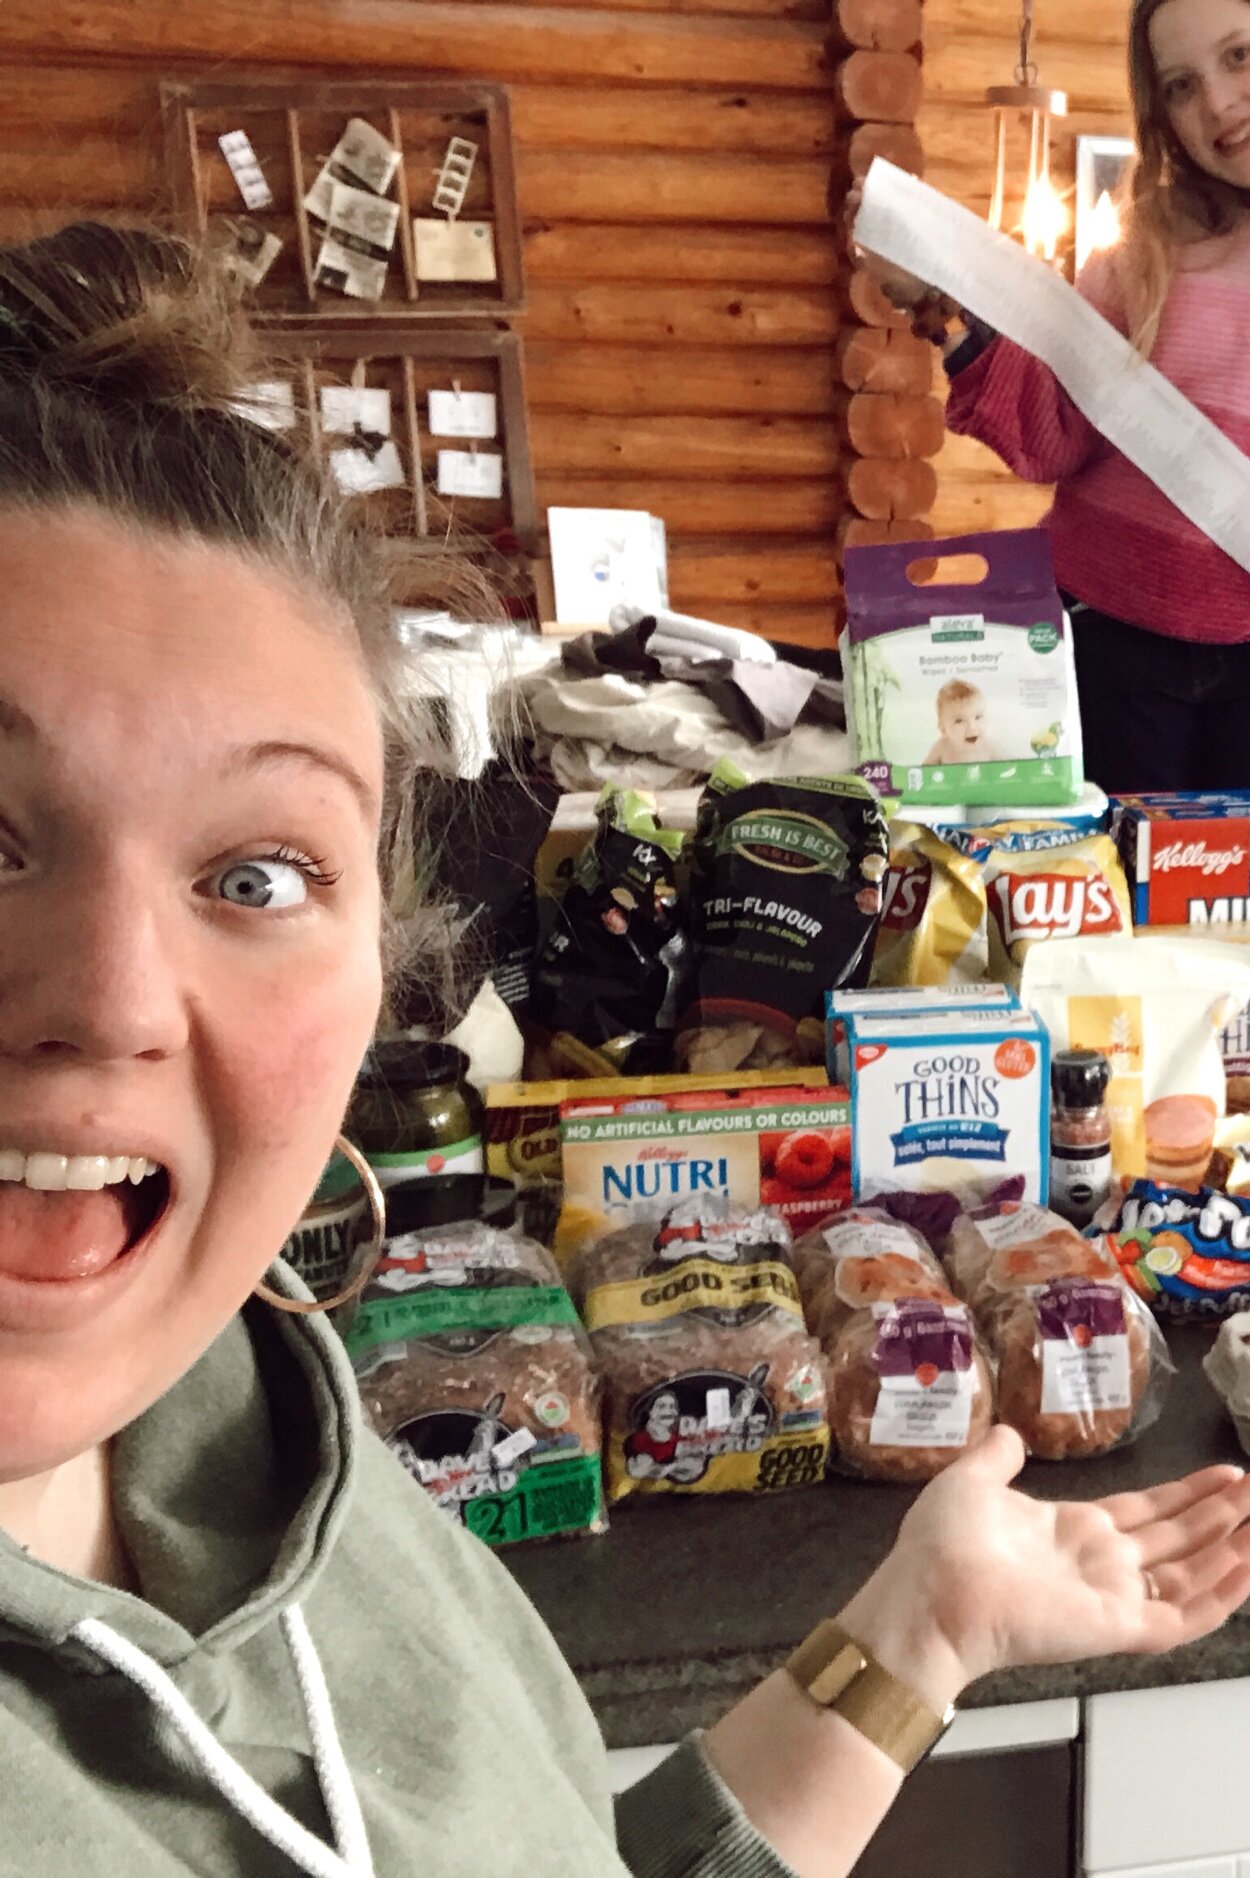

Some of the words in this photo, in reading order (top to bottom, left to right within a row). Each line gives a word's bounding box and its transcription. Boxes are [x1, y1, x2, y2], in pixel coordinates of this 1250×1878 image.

[919, 655, 967, 666] Bamboo
[971, 652, 1000, 664] Baby
[863, 767, 889, 780] 240
[731, 823, 782, 841] FRESH
[785, 830, 800, 845] IS
[802, 834, 841, 860] BEST
[1153, 841, 1248, 875] Kellogg's
[703, 896, 823, 939] TRI-FLAVOUR
[995, 873, 1114, 942] Lay's
[913, 1055, 981, 1077] GOOD
[567, 1124, 590, 1139] NO
[595, 1119, 674, 1138] ARTIFICIAL
[678, 1112, 752, 1133] FLAVOURS
[756, 1111, 777, 1128] OR
[781, 1107, 847, 1126] COLOURS
[520, 1137, 560, 1160] OLD
[603, 1158, 728, 1202] NUTRI
[1066, 1163, 1096, 1176] SALT
[641, 1271, 723, 1307] GOOD
[759, 1443, 824, 1471] GOOD
[476, 1491, 529, 1540] 21
